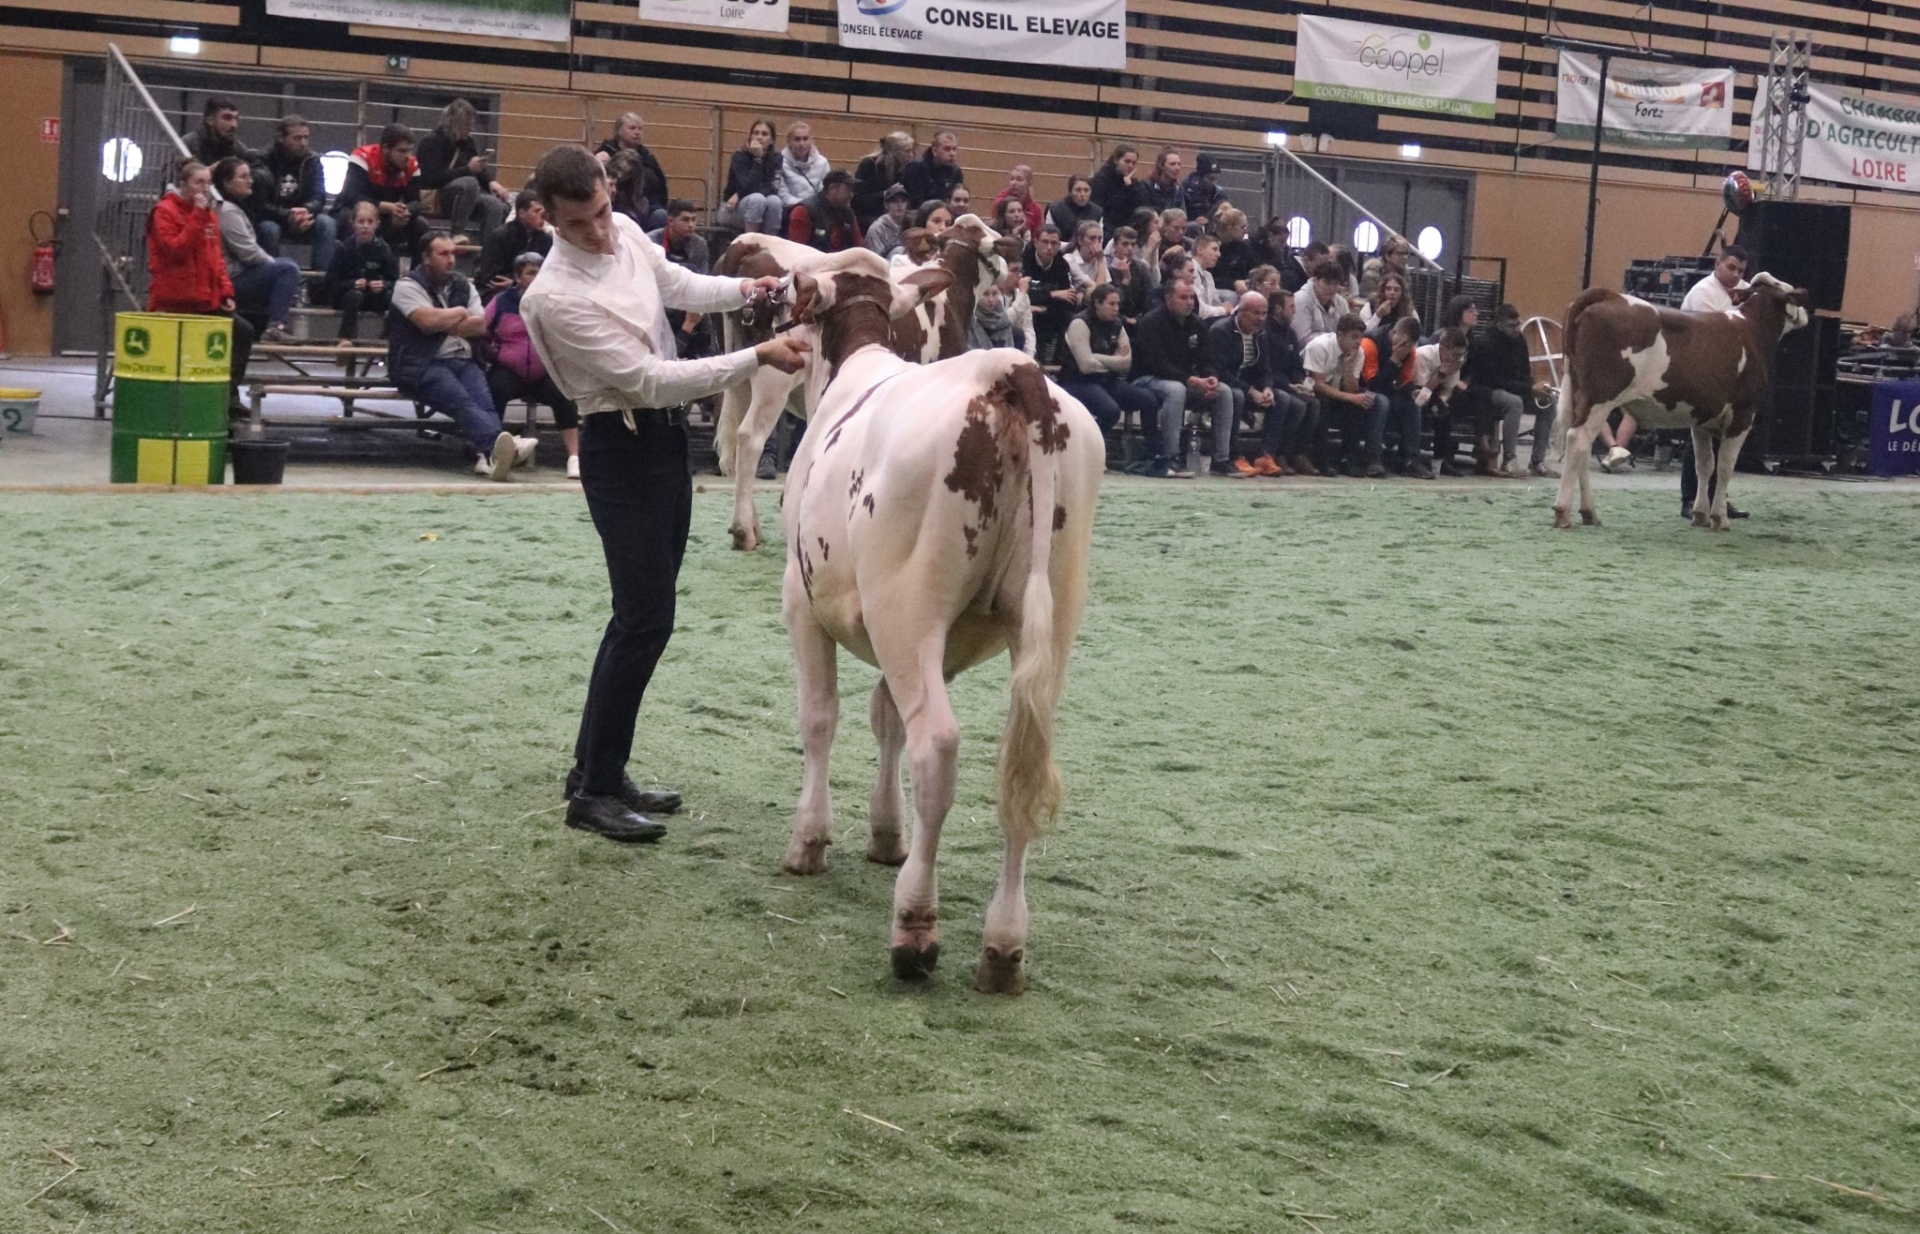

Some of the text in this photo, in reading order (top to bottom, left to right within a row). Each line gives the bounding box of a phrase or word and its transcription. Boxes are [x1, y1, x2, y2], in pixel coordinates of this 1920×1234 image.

[720, 5, 745, 19] Loire
[925, 6, 1120, 39] CONSEIL ELEVAGE
[1359, 46, 1445, 80] coopel
[1315, 85, 1376, 102] COOPERATIVE
[1440, 99, 1450, 110] LA
[1451, 102, 1473, 114] LOIRE
[1805, 119, 1920, 154] D'AGRICULT
[1851, 157, 1907, 183] LOIRE
[2, 407, 28, 433] 2
[1888, 441, 1899, 452] LE
